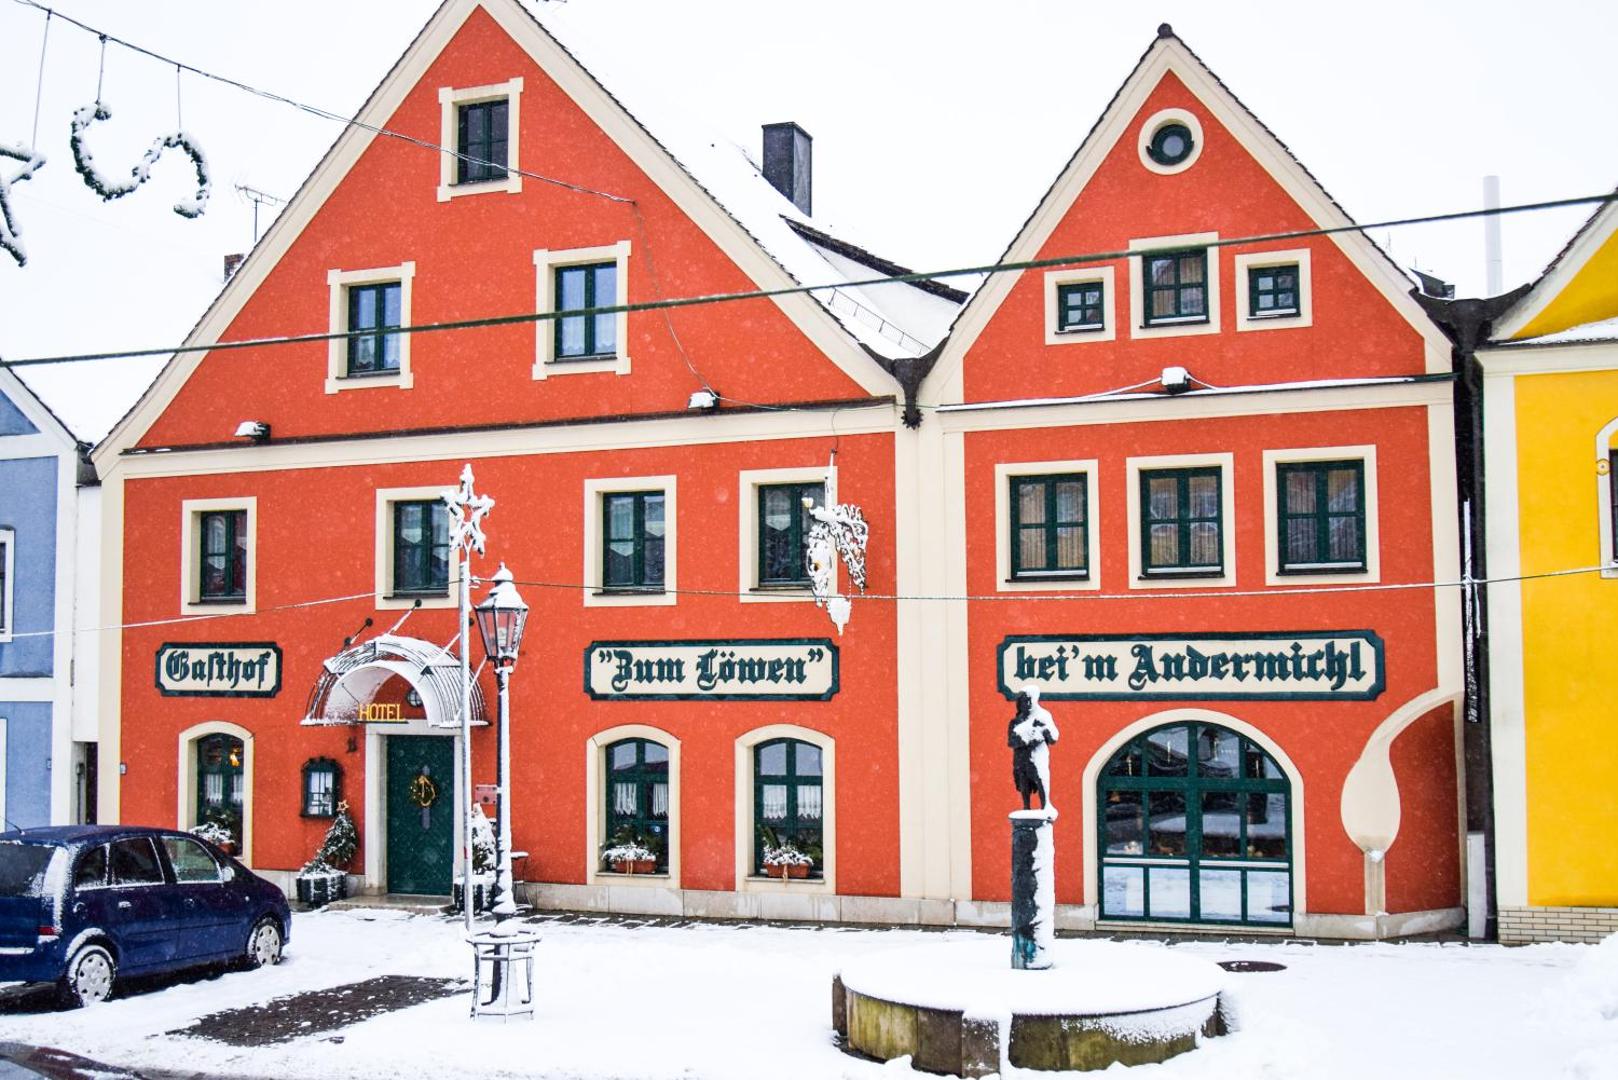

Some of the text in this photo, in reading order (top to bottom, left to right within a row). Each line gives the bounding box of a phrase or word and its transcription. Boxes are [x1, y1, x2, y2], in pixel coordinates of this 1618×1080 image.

[1013, 640, 1367, 691] bei'm Andermichl
[358, 703, 406, 721] HOTEL
